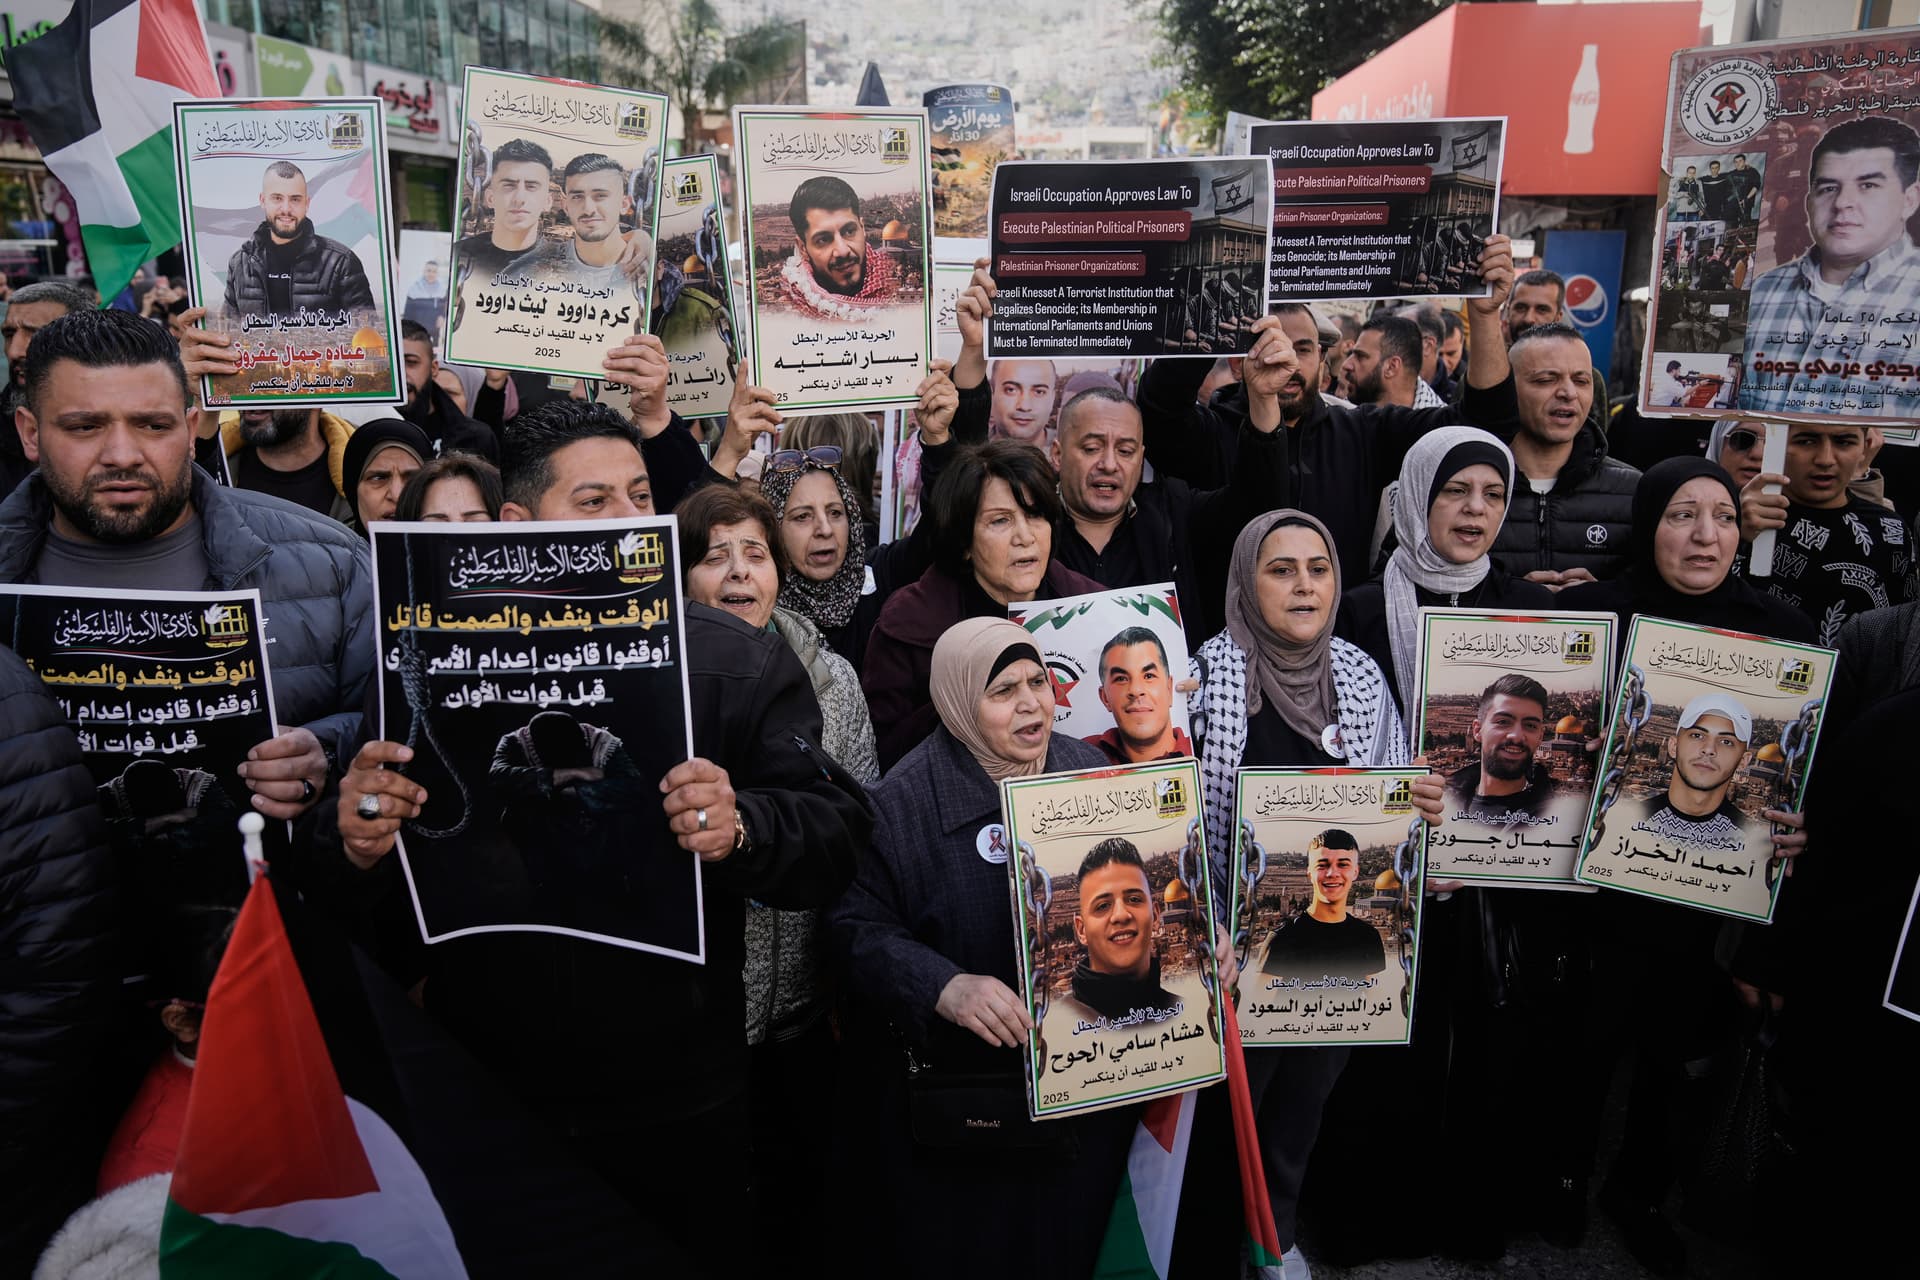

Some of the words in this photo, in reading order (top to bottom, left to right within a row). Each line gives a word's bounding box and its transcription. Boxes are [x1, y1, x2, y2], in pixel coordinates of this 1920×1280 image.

[1709, 60, 1741, 76] الوطنية
[1835, 51, 1884, 72] الوطنية
[1821, 75, 1872, 97] العسكري
[1812, 97, 1854, 118] لتحرير
[932, 106, 977, 133] الأرض
[976, 112, 1001, 130] يوم
[965, 130, 980, 141] 30
[1695, 130, 1732, 143] فلسطين
[1733, 126, 1754, 140] دولة
[1300, 145, 1354, 163] Occupation
[1356, 144, 1402, 161] Approves
[1403, 144, 1422, 157] Law
[1423, 143, 1434, 156] To
[1298, 175, 1346, 189] Palestinian
[1347, 175, 1383, 188] Political
[1383, 174, 1426, 187] Prisoners
[1010, 187, 1041, 202] Israeli
[1042, 188, 1103, 206] Occupation
[1104, 187, 1156, 206] Approves
[1157, 186, 1179, 201] Law
[1179, 185, 1192, 200] To
[1002, 220, 1040, 234] Execute
[1041, 220, 1095, 234] Palestinian
[1096, 220, 1135, 234] Political
[1136, 220, 1185, 234] Prisoners
[1299, 211, 1331, 223] Prisoner
[1331, 210, 1383, 224] Organizations:
[1276, 236, 1308, 247] Knesset
[1308, 236, 1316, 246] A
[1317, 235, 1353, 246] Terrorist
[1353, 234, 1394, 246] Institution
[1394, 234, 1412, 245] that
[1287, 251, 1327, 262] Genocide;
[1327, 250, 1338, 261] its
[1339, 249, 1388, 263] Membership
[1388, 249, 1396, 260] in
[1000, 260, 1044, 271] Palestinian
[1044, 260, 1080, 271] Prisoner
[1080, 259, 1140, 274] Organizations:
[1301, 265, 1348, 277] Parliaments
[1348, 265, 1364, 276] and
[1364, 264, 1391, 275] Unions
[491, 273, 533, 290] الأبطال
[577, 283, 614, 299] الحرية
[1280, 280, 1325, 292] Terminated
[1325, 279, 1372, 293] Immediately
[1021, 287, 1057, 298] Knesset
[1058, 286, 1065, 298] A
[1066, 286, 1107, 298] Terrorist
[1107, 286, 1154, 298] Institution
[1154, 286, 1175, 298] that
[476, 293, 515, 314] داوود
[519, 293, 547, 319] ليث
[557, 302, 596, 323] داوود
[993, 303, 1034, 317] Legalizes
[1035, 302, 1079, 316] Genocide;
[1080, 302, 1092, 314] its
[1092, 302, 1148, 317] Membership
[1148, 302, 1158, 314] in
[242, 312, 277, 333] البطل
[279, 307, 316, 332] للأسير
[318, 308, 351, 331] الحرية
[600, 305, 631, 327] كرم
[993, 319, 1050, 332] International
[1051, 318, 1103, 331] Parliaments
[1104, 319, 1121, 331] and
[1122, 319, 1153, 331] Unions
[495, 323, 531, 335] ينكسر
[532, 325, 544, 338] أن
[547, 329, 575, 341] للقيد
[595, 333, 605, 343] لا
[825, 331, 858, 345] للأسير
[860, 329, 895, 343] الحرية
[579, 335, 592, 344] بد
[791, 333, 823, 346] البطل
[993, 336, 1015, 348] Must
[1016, 336, 1027, 347] be
[1028, 335, 1078, 348] Terminated
[1079, 334, 1132, 350] Immediately
[281, 345, 322, 367] جمال
[326, 344, 365, 366] عباده
[535, 347, 561, 358] 2025
[675, 351, 706, 365] الحرية
[774, 350, 857, 373] اشتيه
[859, 350, 919, 369] يسار
[1753, 352, 1801, 377] جودة
[1804, 353, 1861, 380] عزمي
[683, 366, 726, 386] رائد
[387, 602, 433, 633] قاتل
[436, 604, 533, 636] والصمت
[538, 603, 592, 633] ينفد
[598, 597, 669, 631] الوقت
[477, 646, 538, 677] إعدام
[543, 642, 601, 673] قانون
[605, 634, 671, 669] أوقفوا
[40, 663, 127, 691] والصمت
[133, 664, 184, 690] ينفد
[187, 659, 256, 687] الوقت
[445, 679, 501, 709] الأوان
[507, 679, 563, 708] فوات
[567, 677, 607, 708] قبل
[77, 699, 133, 727] إعدام
[138, 698, 191, 726] قانون
[196, 689, 259, 721] أوقفوا
[103, 731, 157, 757] فوات
[161, 729, 198, 755] قبل
[1451, 810, 1483, 825] البطل
[1521, 811, 1559, 827] الحرية
[1428, 830, 1502, 849] جوري
[1505, 832, 1582, 849] كمال
[1610, 835, 1687, 865] الخراز
[1587, 864, 1613, 878] 2025
[1691, 855, 1756, 879] أحمد
[1265, 977, 1300, 992] البطل
[1302, 974, 1338, 992] للأسير
[1340, 976, 1378, 992] الحرية
[1146, 1001, 1184, 1023] الحرية
[1248, 998, 1298, 1018] السعود
[1300, 994, 1323, 1019] أبو
[1325, 997, 1367, 1018] الدين
[1368, 996, 1392, 1016] نور
[1072, 1017, 1106, 1036] البطل
[1109, 1007, 1146, 1030] للأسير
[1160, 1023, 1205, 1052] هشام
[1051, 1041, 1104, 1073] الحوح
[1109, 1033, 1156, 1063] سامي
[1131, 1061, 1157, 1078] للقيد
[1161, 1058, 1174, 1072] بد
[1176, 1055, 1184, 1066] لا
[1080, 1070, 1116, 1089] ينكسر
[1117, 1065, 1128, 1082] أن
[1043, 1091, 1070, 1105] 2025
